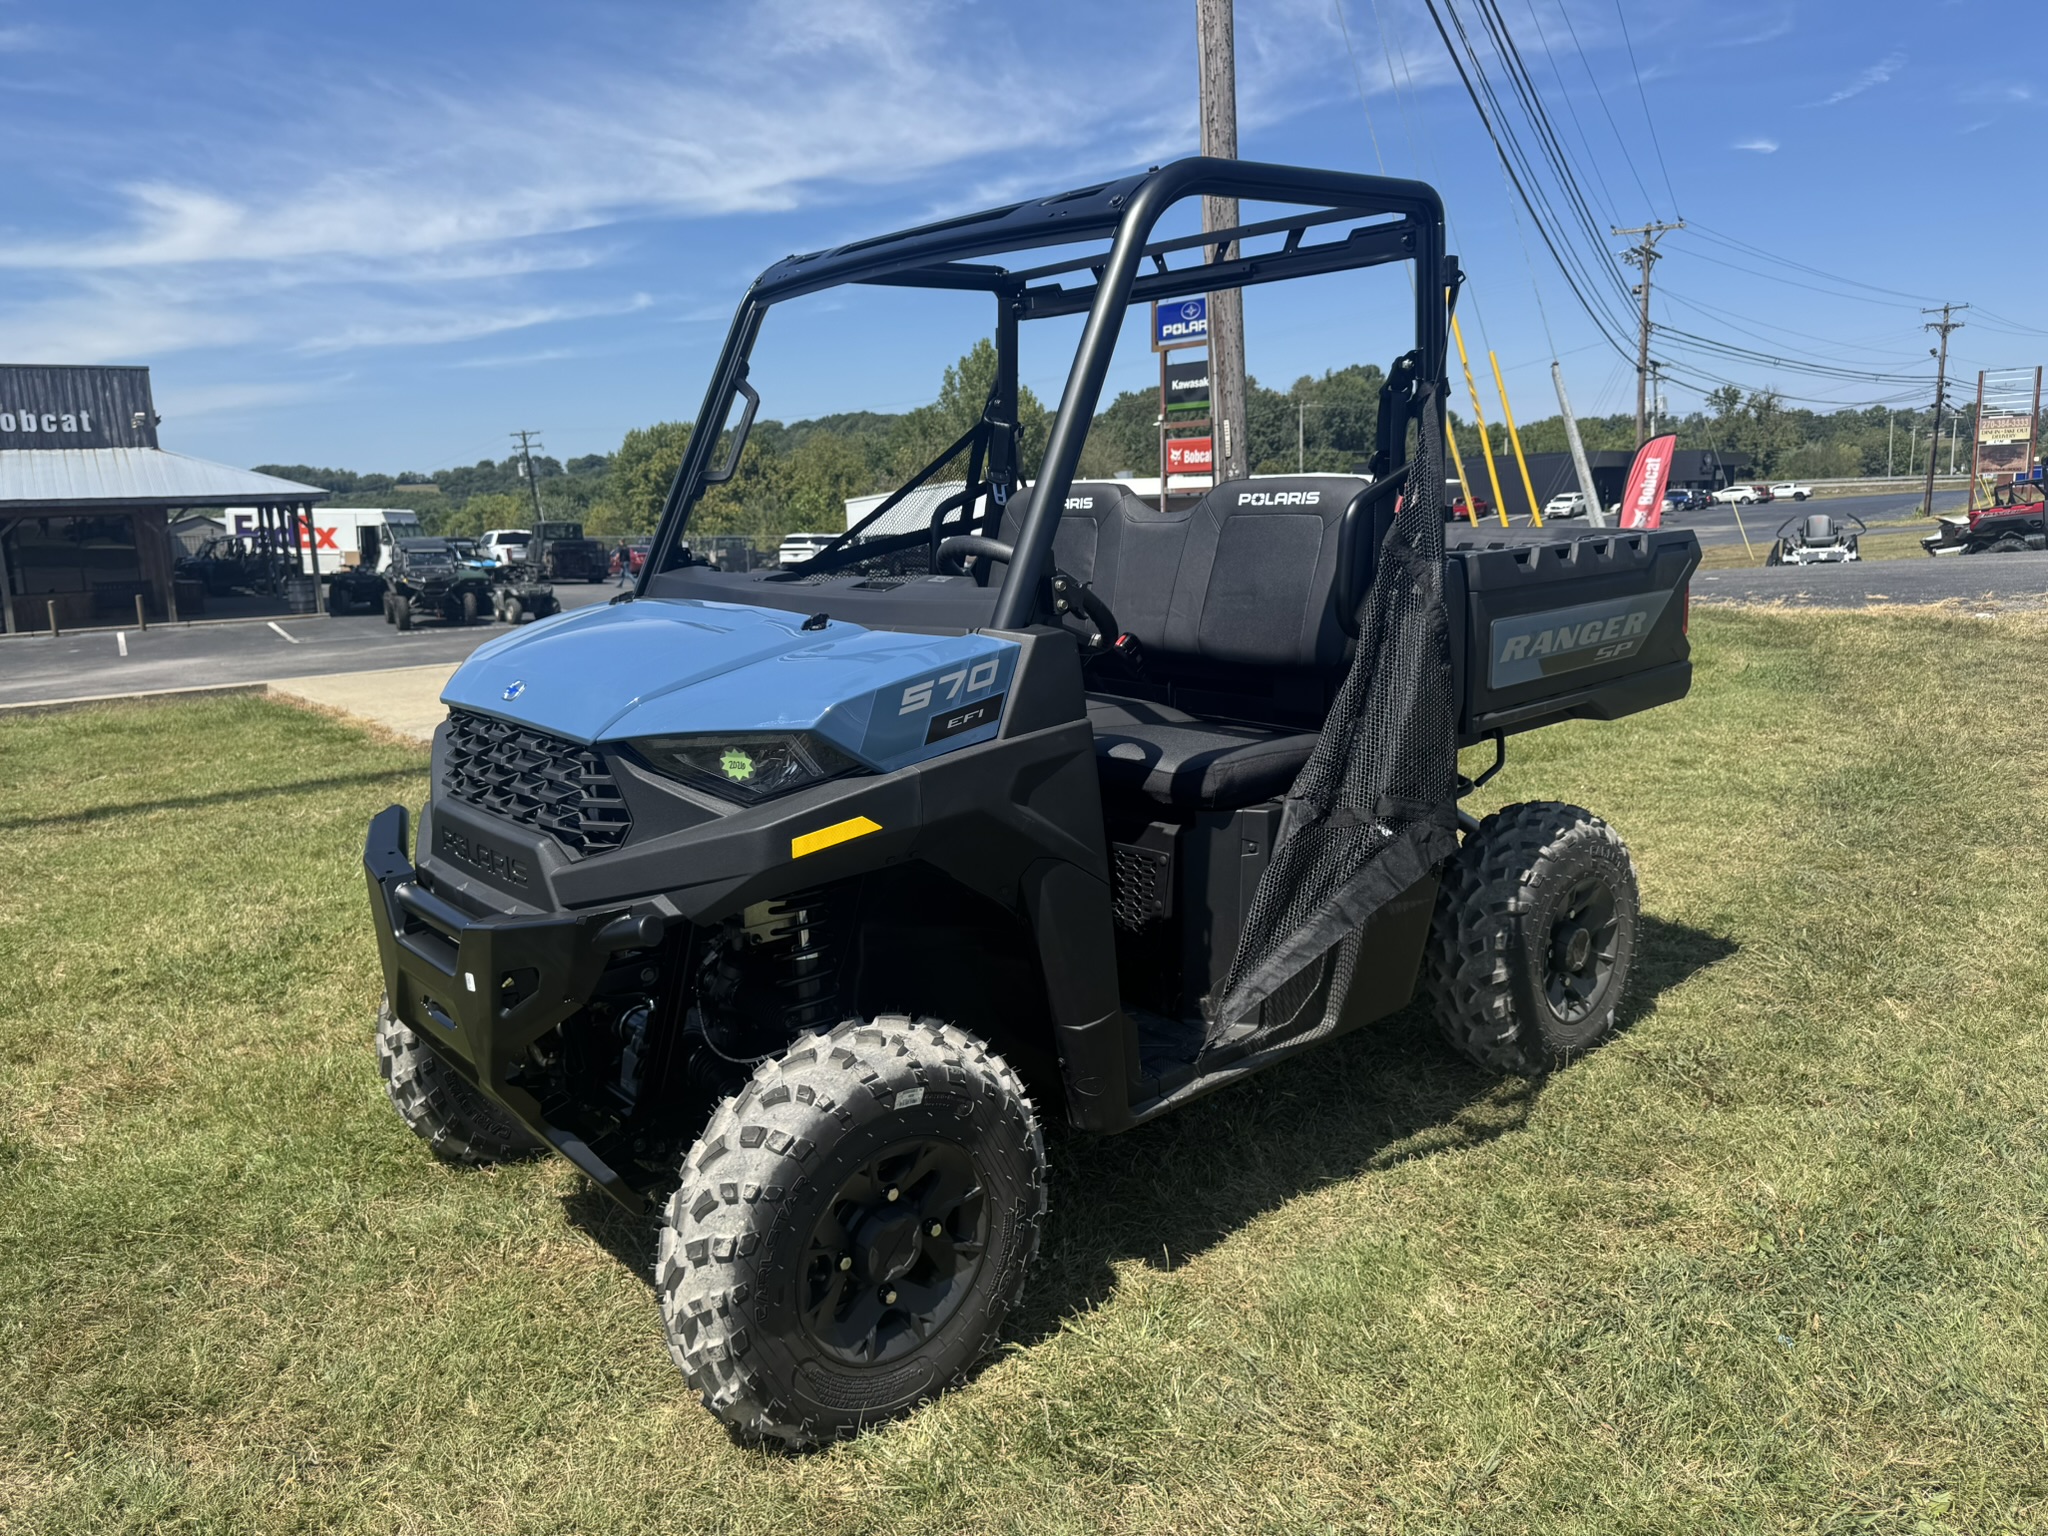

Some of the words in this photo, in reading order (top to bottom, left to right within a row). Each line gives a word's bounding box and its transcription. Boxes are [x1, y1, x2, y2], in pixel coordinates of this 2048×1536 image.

[1238, 491, 1320, 506] POLARIS
[1637, 457, 1661, 505] Bobcat
[1499, 611, 1648, 664] RANGER
[1593, 640, 1635, 661] SP
[899, 659, 1000, 716] 570
[947, 708, 985, 729] EFI
[442, 826, 529, 889] POLARIS
[754, 1175, 810, 1322] CARLSTAR
